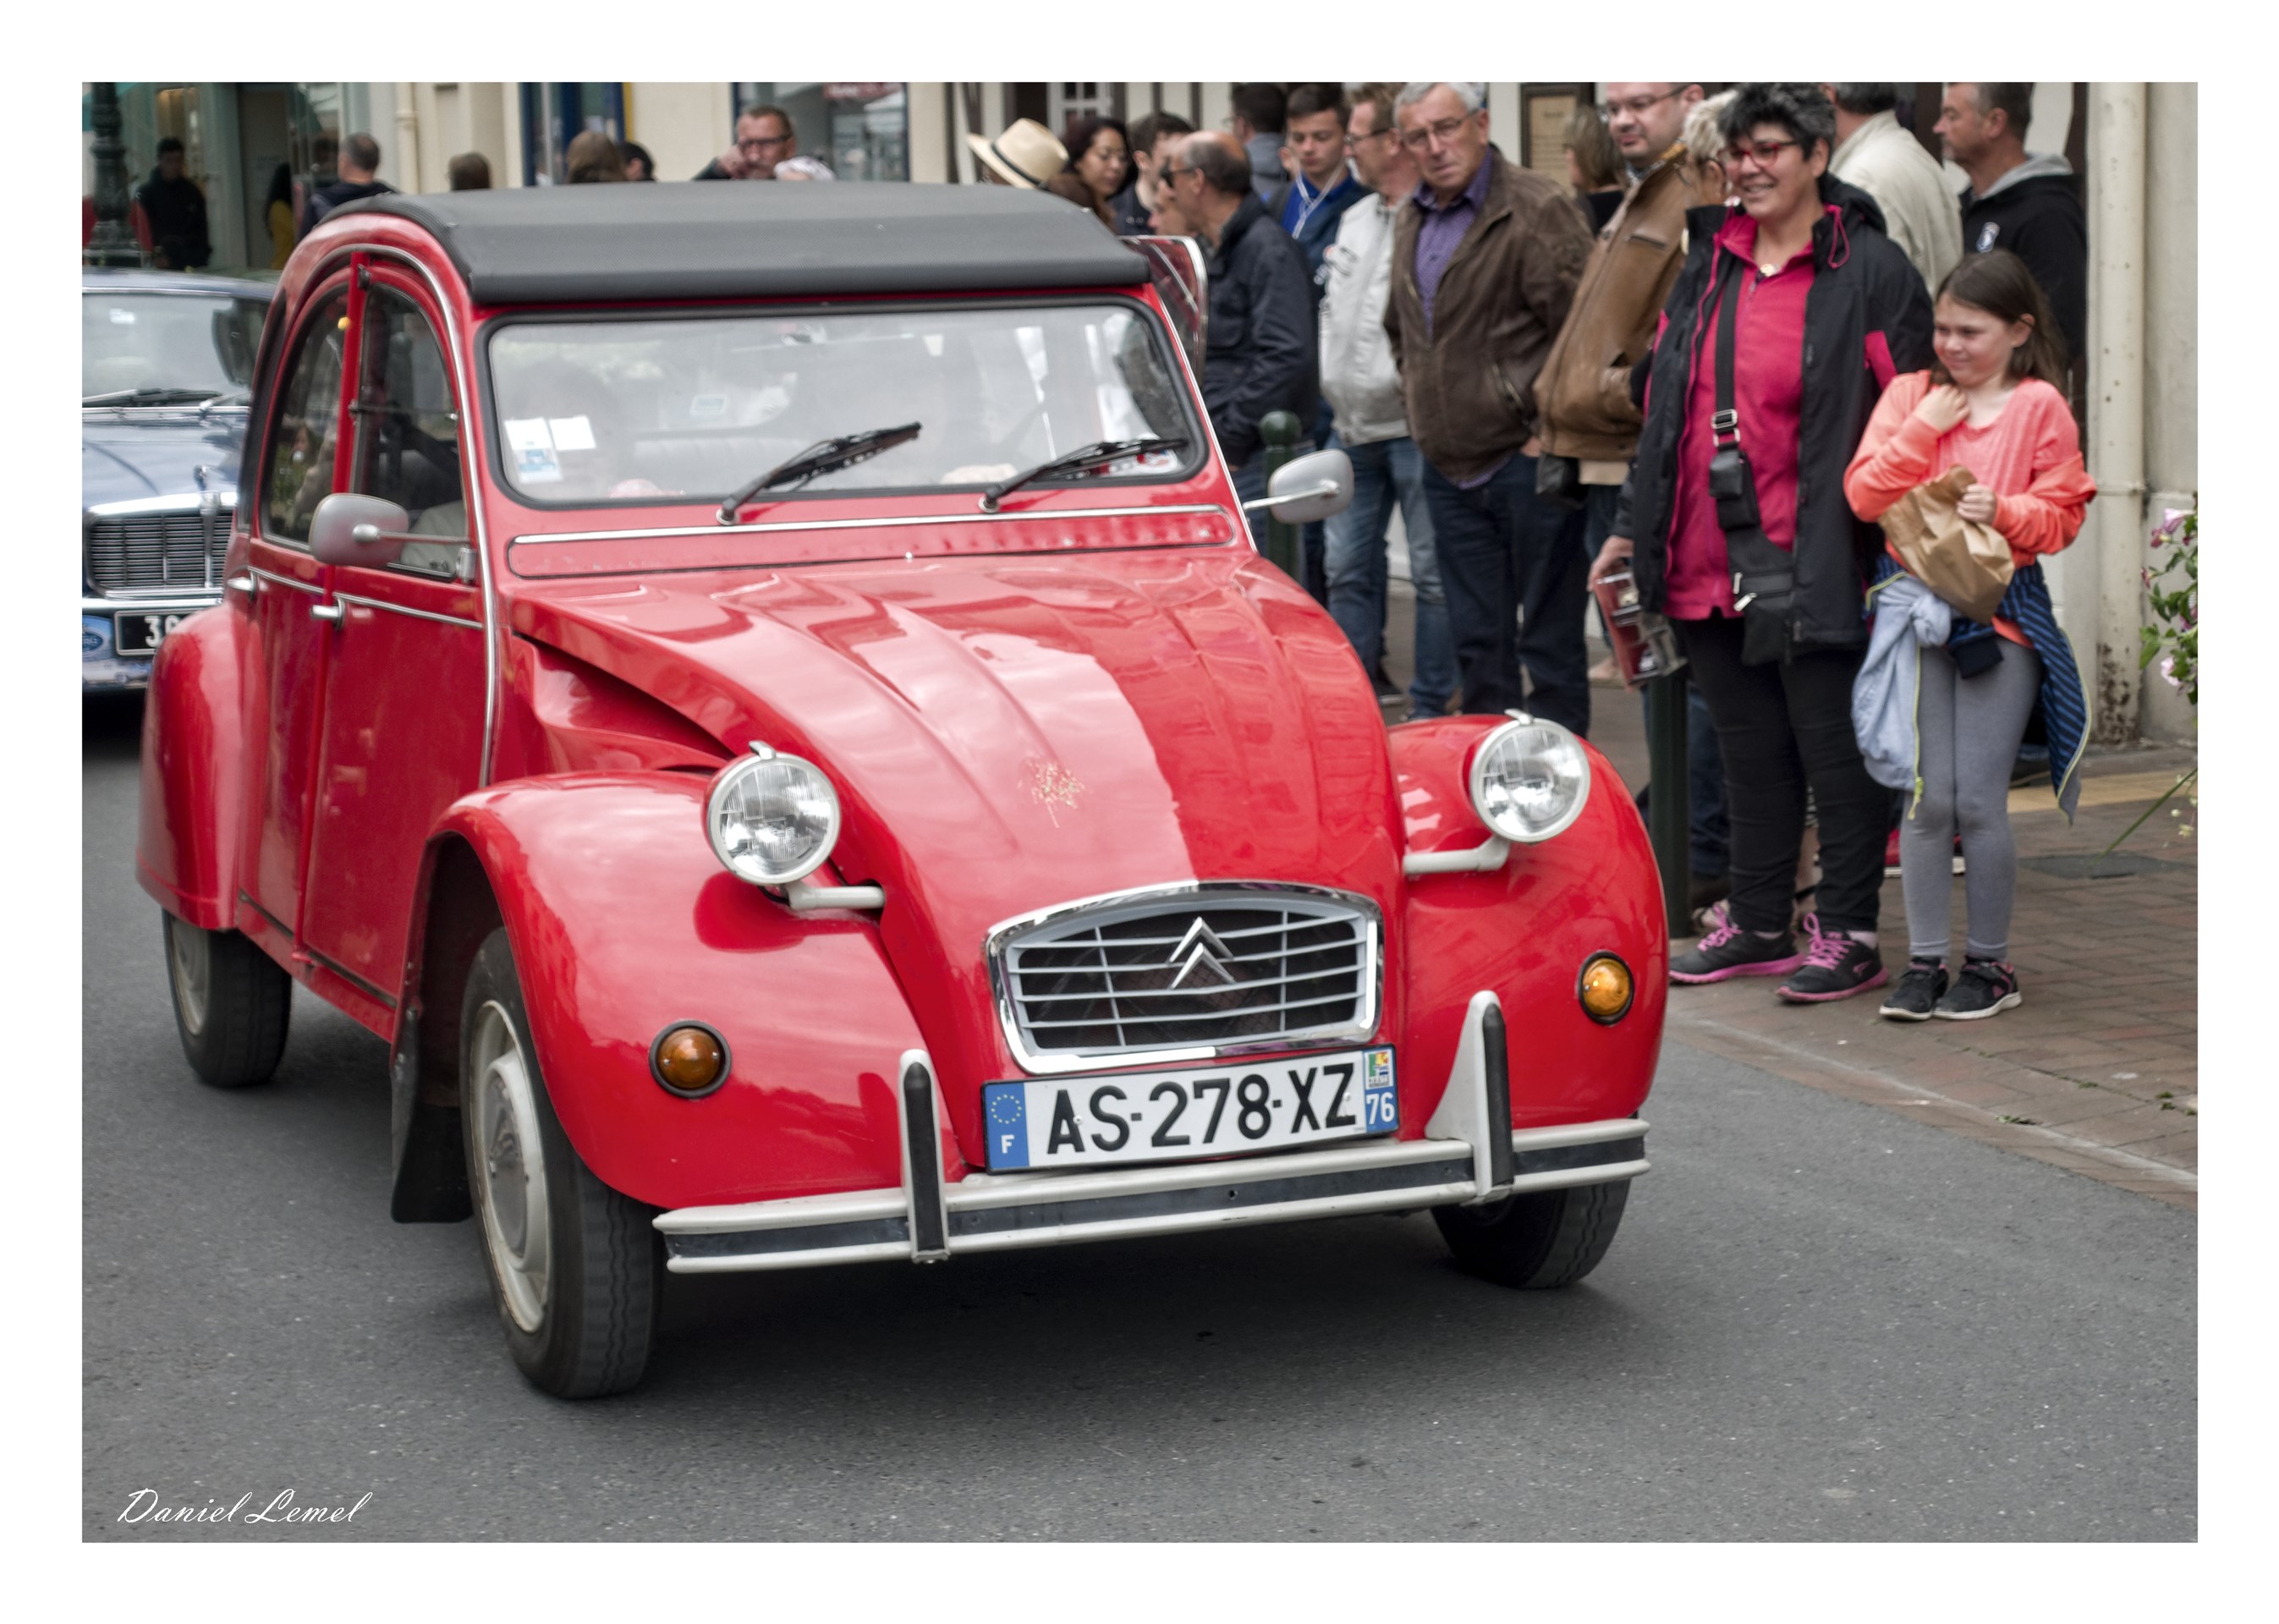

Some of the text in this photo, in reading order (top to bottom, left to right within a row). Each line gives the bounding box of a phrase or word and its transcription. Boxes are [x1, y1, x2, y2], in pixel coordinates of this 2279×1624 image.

[1046, 1062, 1357, 1155] AS-278-XZ
[1366, 1092, 1395, 1124] 76
[1001, 1134, 1014, 1154] F
